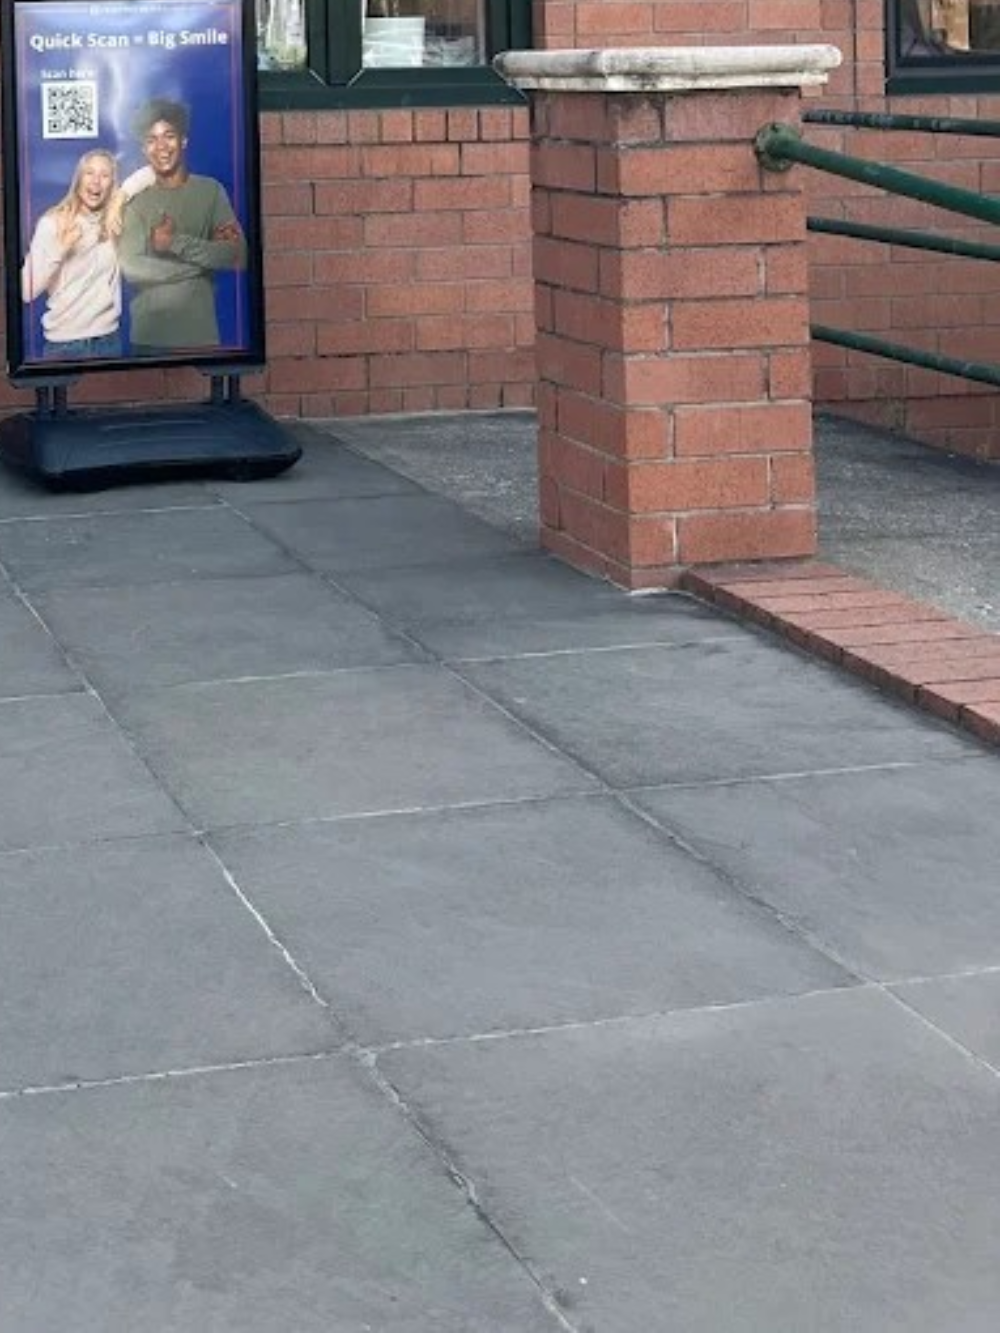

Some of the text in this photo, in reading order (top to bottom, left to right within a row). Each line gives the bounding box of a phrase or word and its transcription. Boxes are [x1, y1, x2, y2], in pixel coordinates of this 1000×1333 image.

[29, 32, 83, 52] Quick
[87, 32, 130, 48] Scan
[147, 30, 176, 50] Big
[179, 28, 229, 46] Smile
